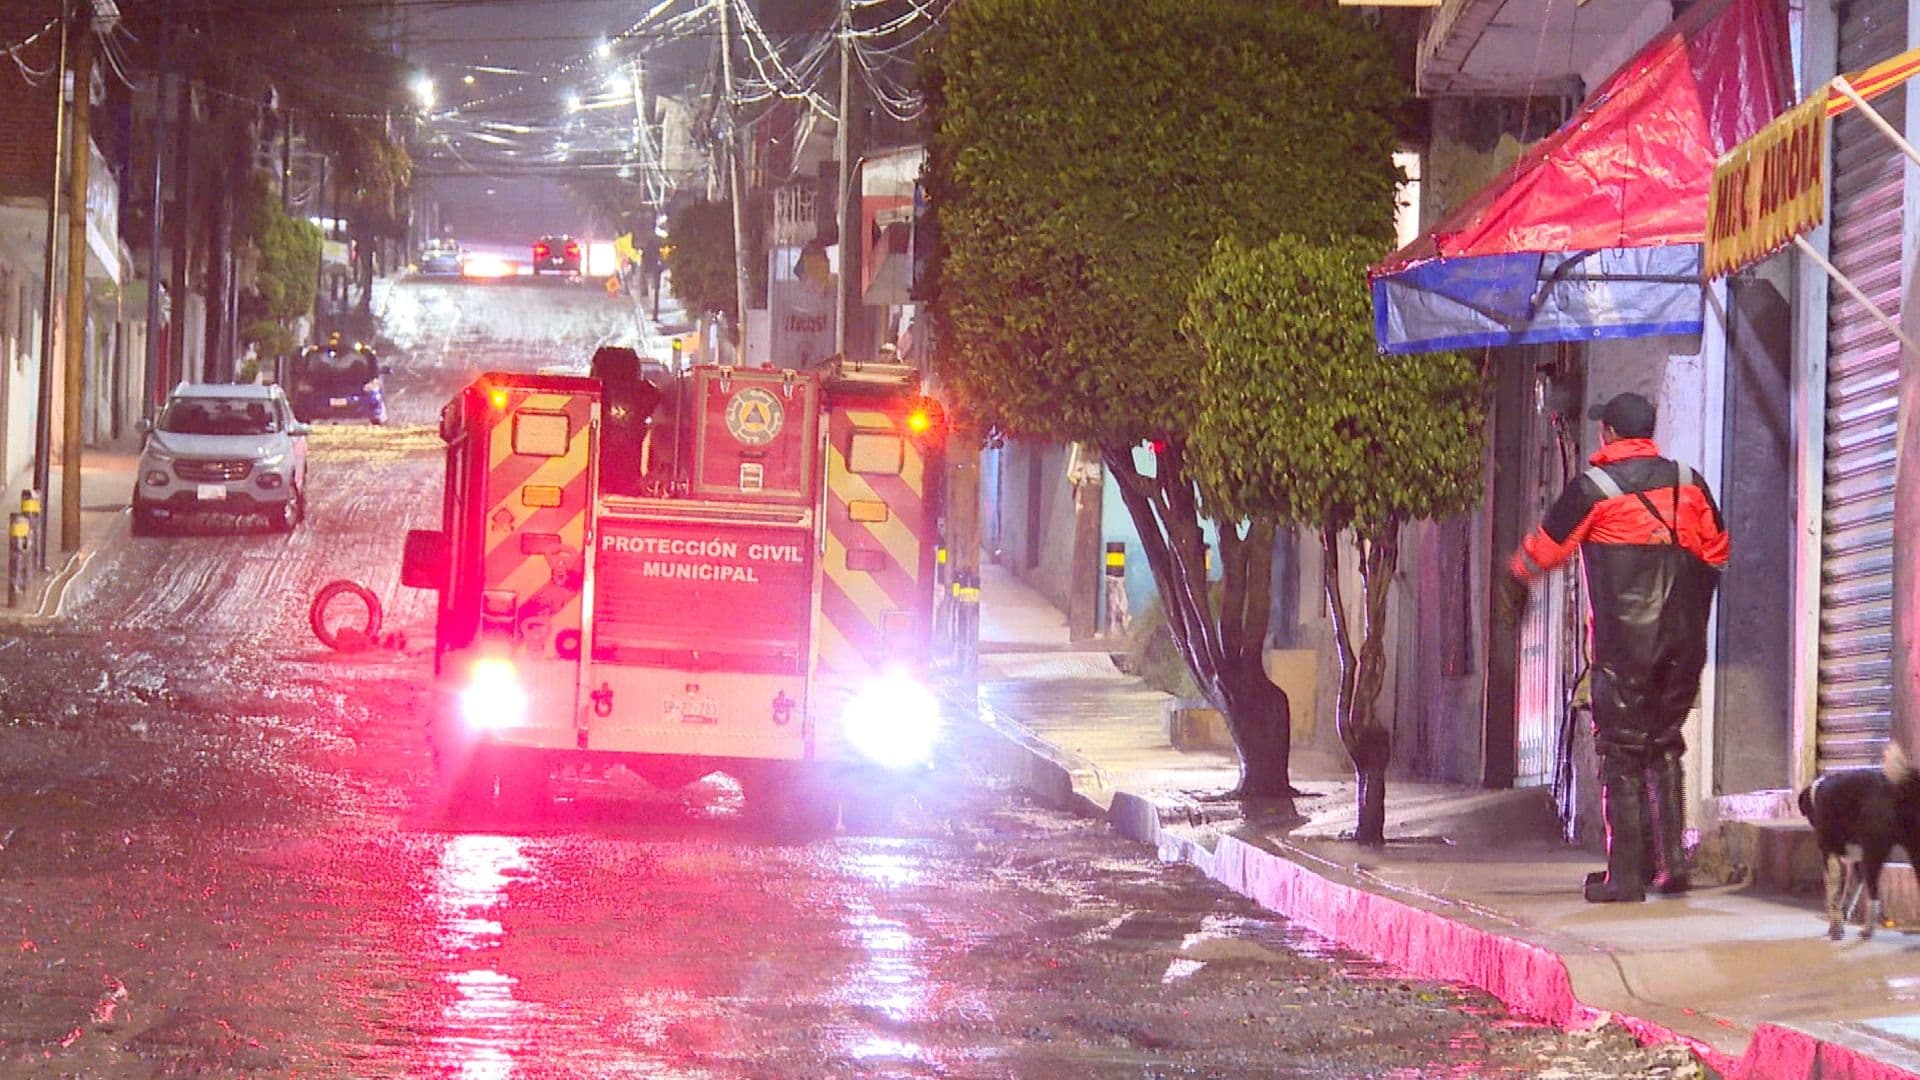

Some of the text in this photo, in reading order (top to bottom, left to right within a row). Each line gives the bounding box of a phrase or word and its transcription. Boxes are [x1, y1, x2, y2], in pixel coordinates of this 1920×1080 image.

[602, 535, 804, 562] PROTECCIÓN CIVIL
[643, 561, 758, 582] MUNICIPAL
